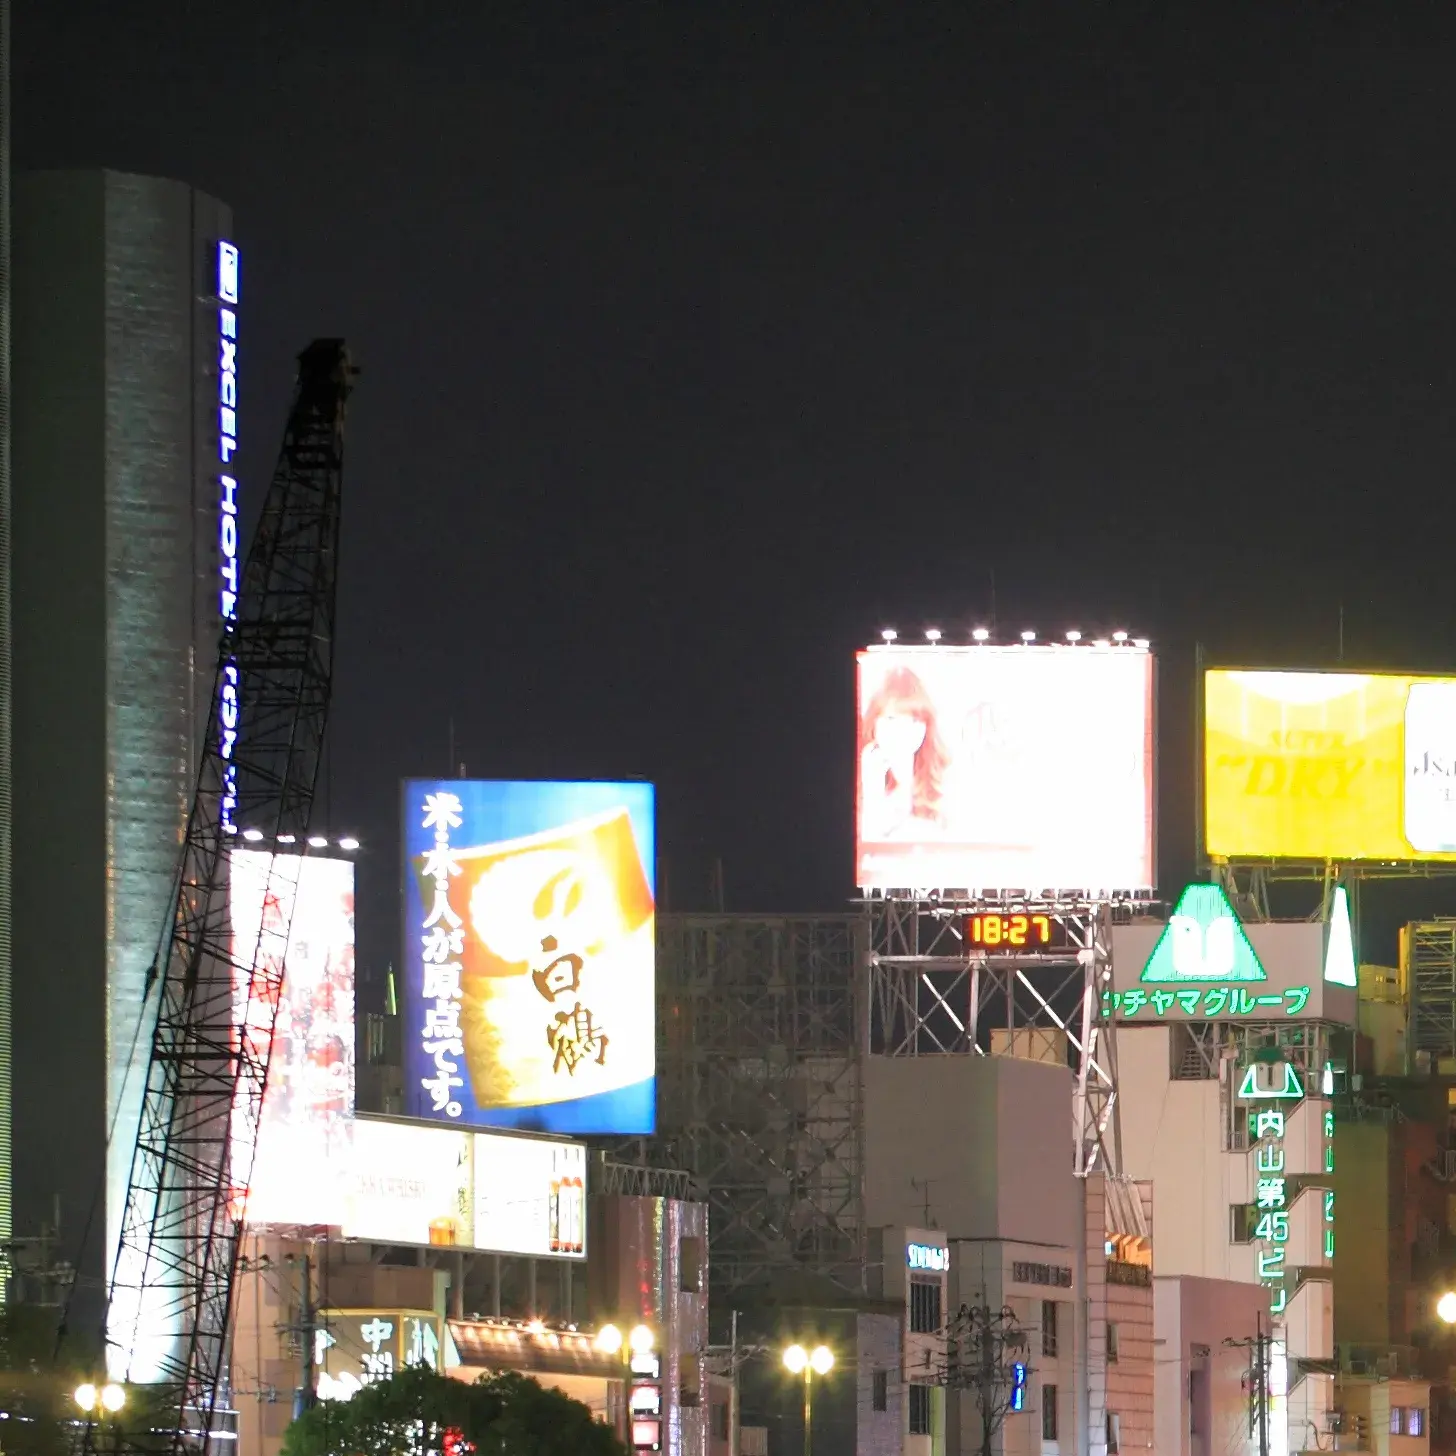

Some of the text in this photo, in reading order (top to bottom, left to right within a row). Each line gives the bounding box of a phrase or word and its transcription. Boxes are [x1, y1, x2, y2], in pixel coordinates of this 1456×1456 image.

[220, 308, 237, 463] EXCEL
[220, 476, 237, 633] HOTE
[531, 933, 609, 1077] 白鶴
[972, 916, 1050, 945] 18:27
